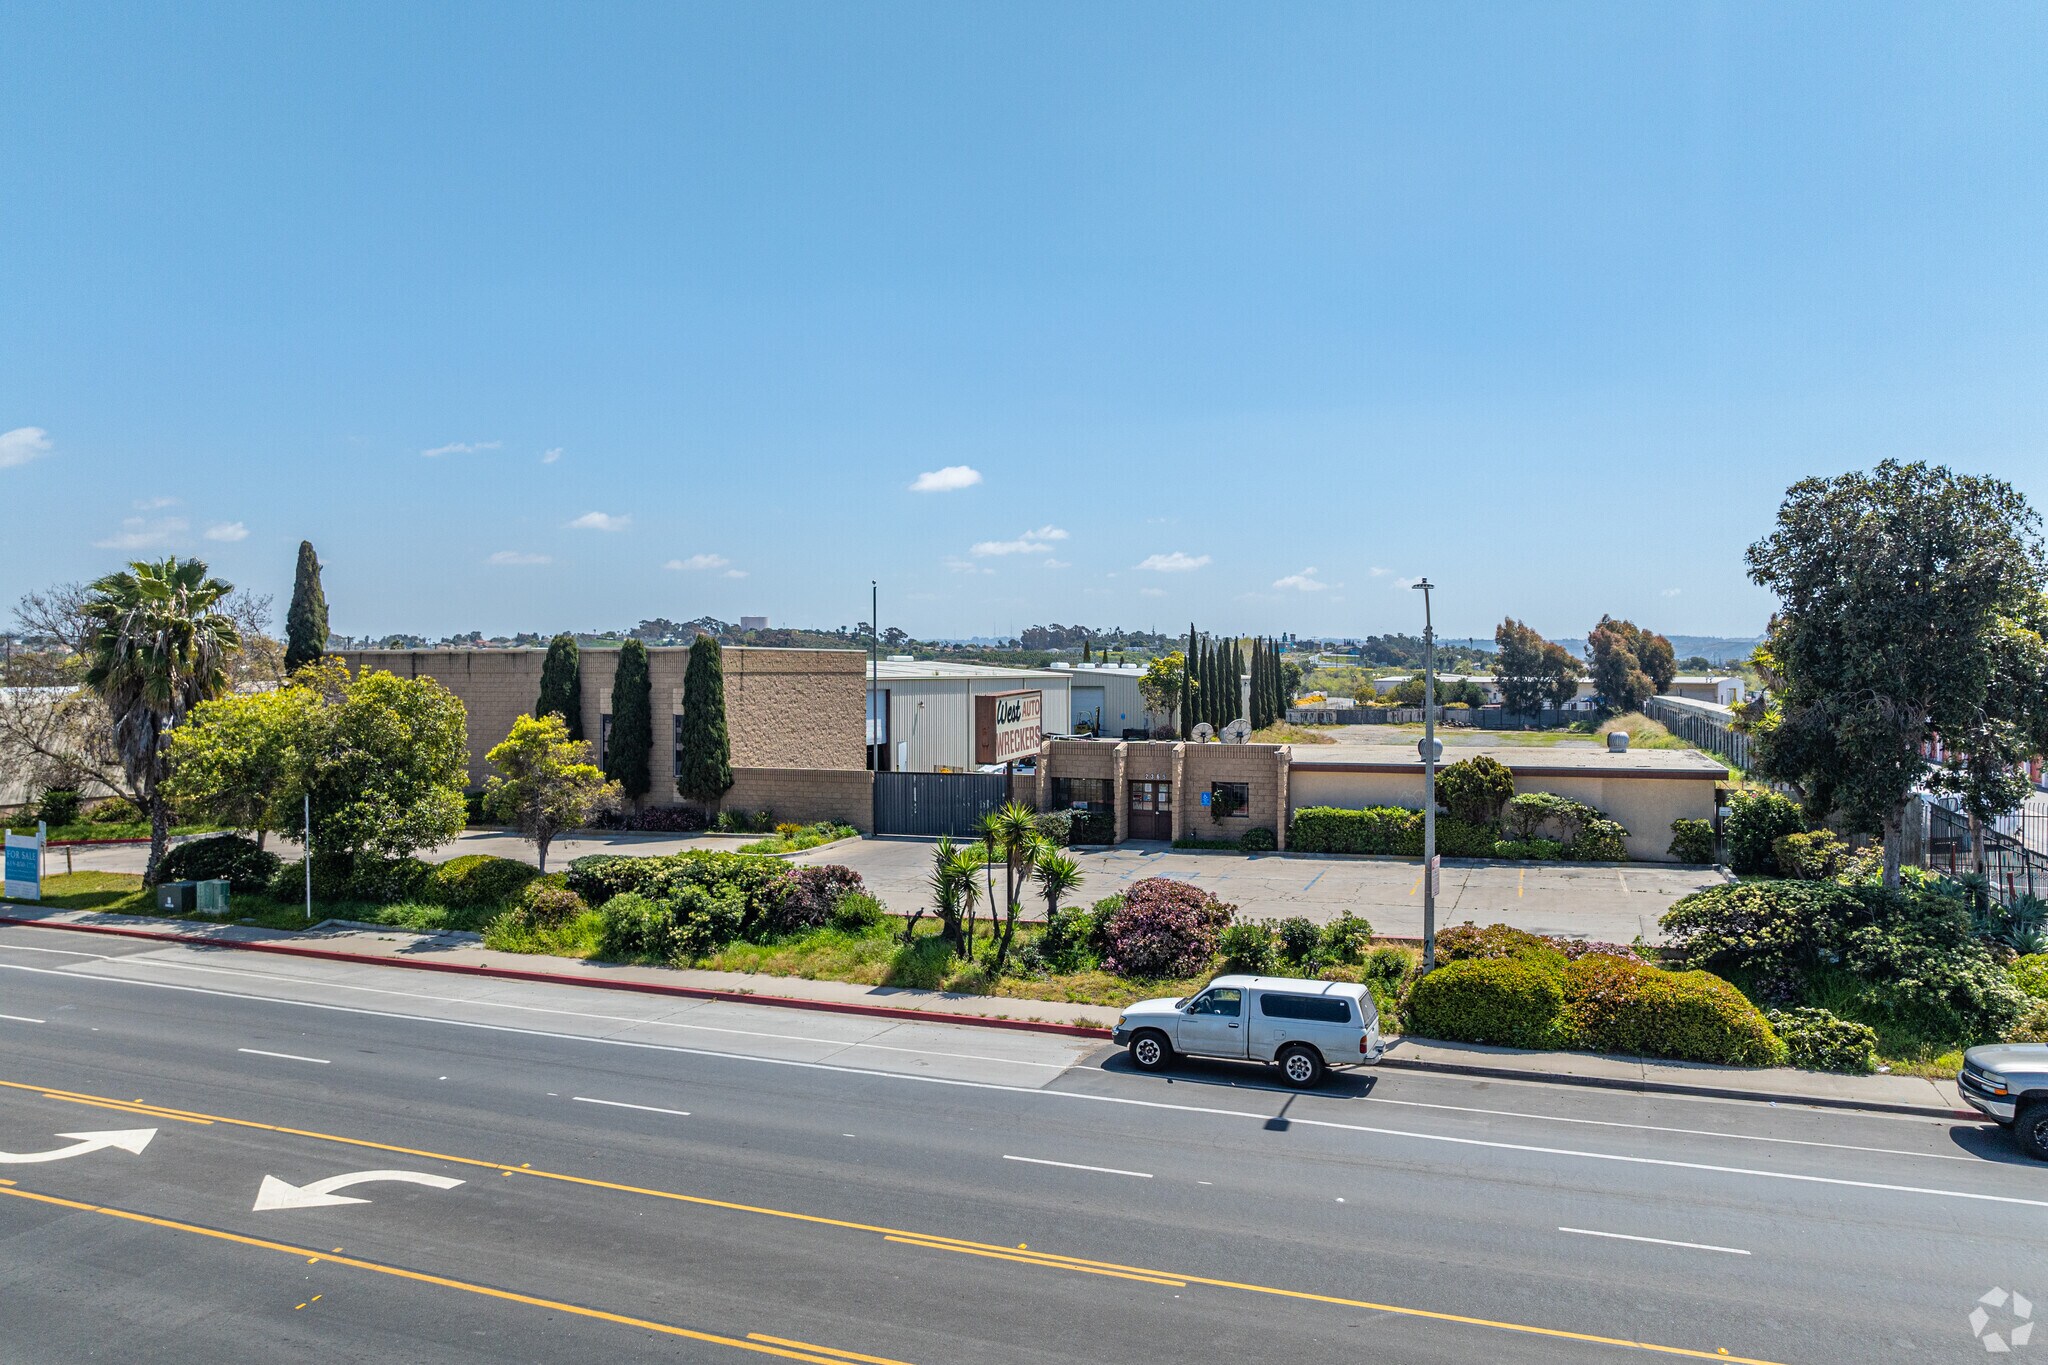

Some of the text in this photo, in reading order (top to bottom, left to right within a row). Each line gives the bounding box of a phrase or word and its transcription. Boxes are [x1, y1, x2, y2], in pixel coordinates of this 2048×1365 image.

[997, 699, 1040, 725] West AUTO
[996, 725, 1040, 757] WRECKERS
[6, 850, 36, 861] FOR SALE
